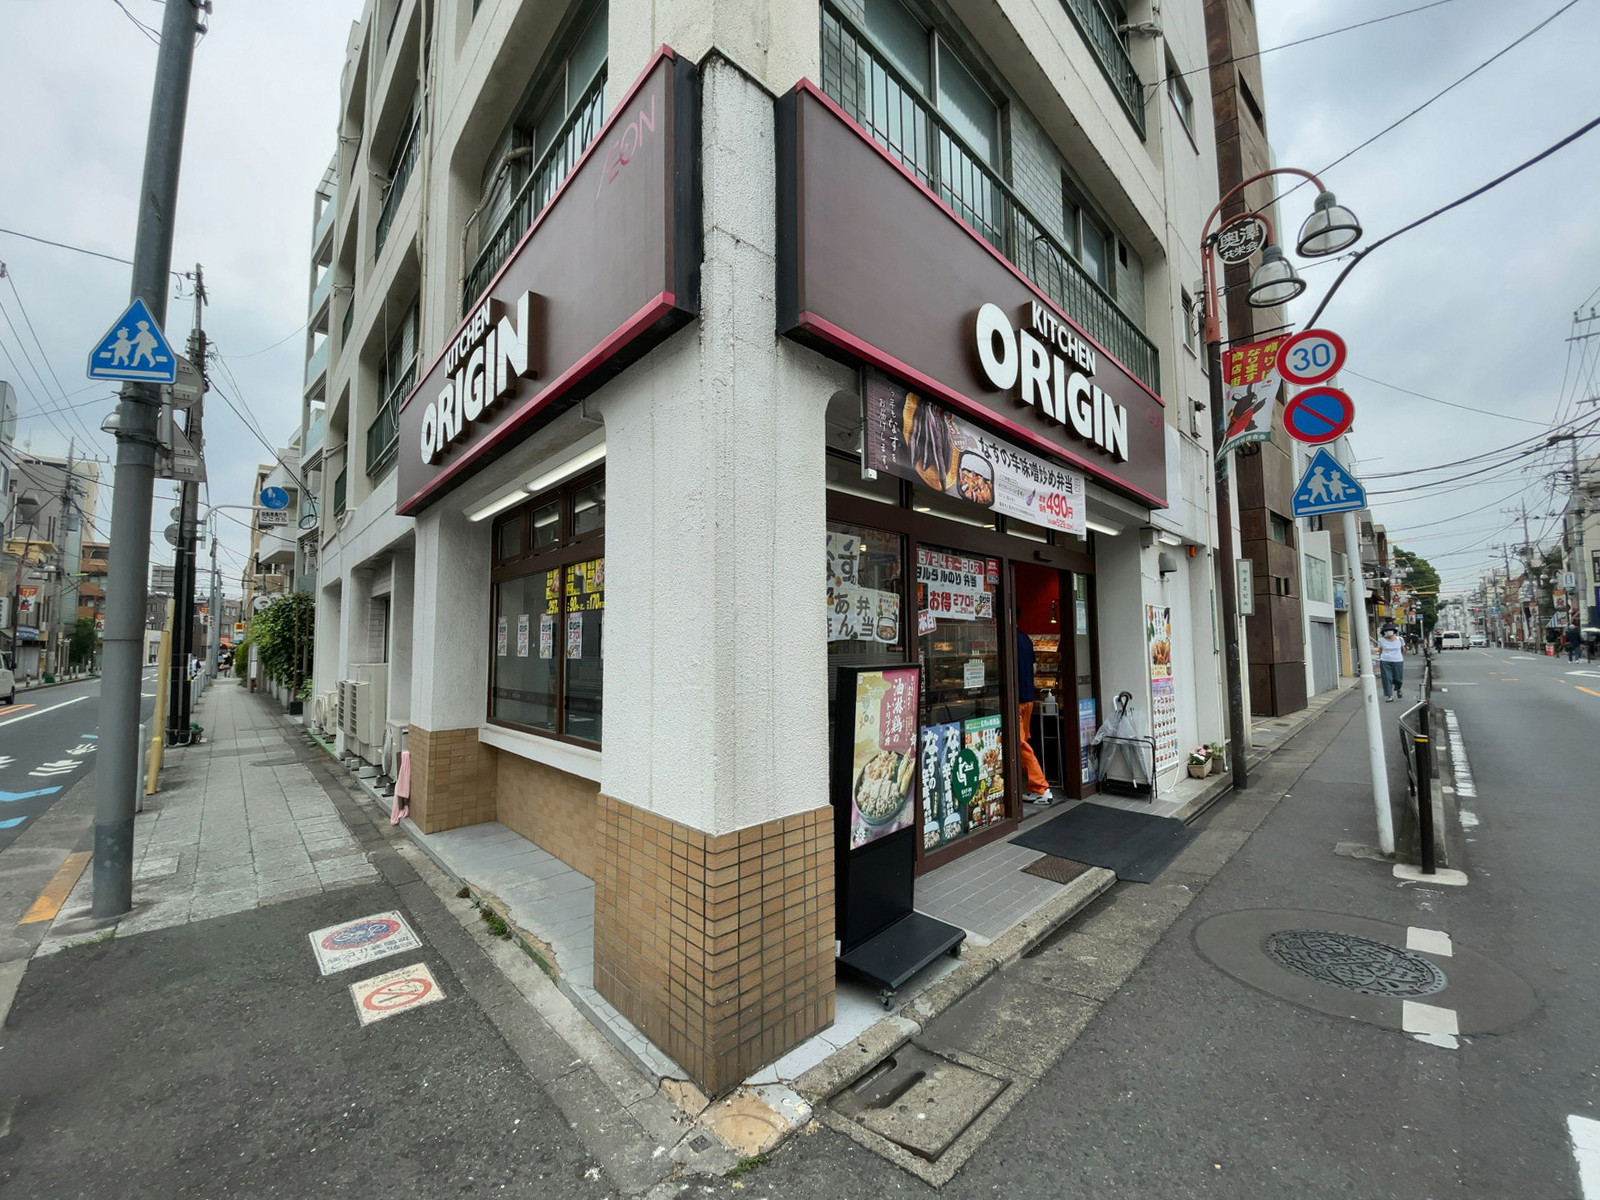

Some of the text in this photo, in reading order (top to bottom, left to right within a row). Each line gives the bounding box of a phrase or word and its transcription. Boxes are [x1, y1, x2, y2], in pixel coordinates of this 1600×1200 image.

[1223, 241, 1259, 261] 共栄会
[444, 297, 493, 380] KITCHEN
[1031, 300, 1097, 377] KITCHEN
[1292, 343, 1331, 371] 30
[420, 290, 531, 466] ORIGIN
[975, 302, 1129, 464] ORIGIN
[1230, 351, 1245, 388] 商店街
[1244, 348, 1262, 383] なります
[977, 436, 1074, 495] なすの辛味噌炒め弁当
[1046, 492, 1074, 519] 490円
[929, 590, 952, 613] お得
[923, 730, 939, 790] なすの
